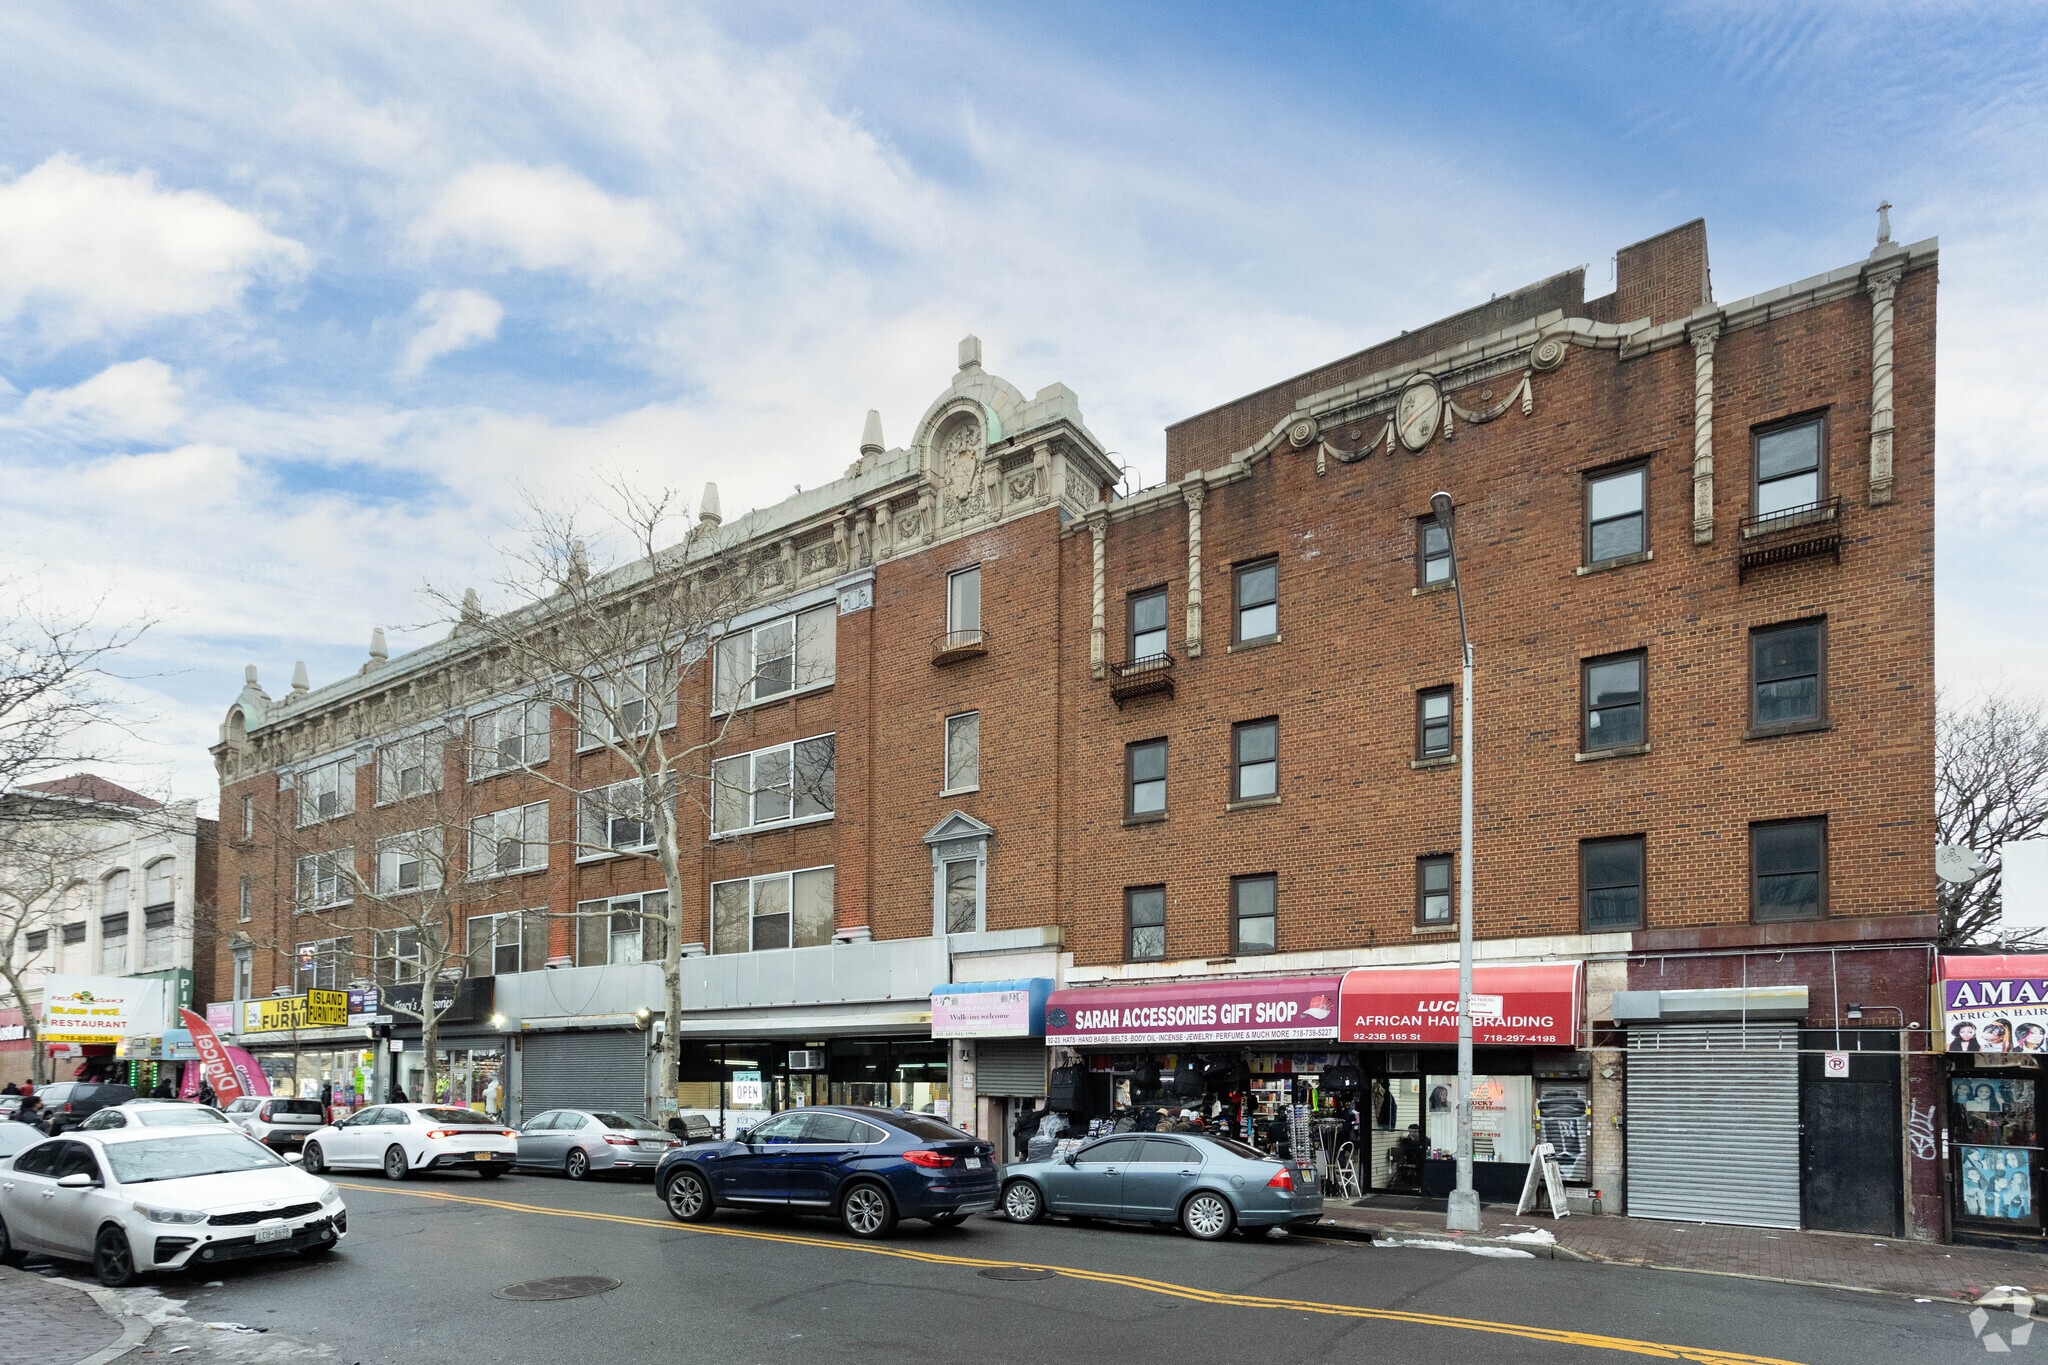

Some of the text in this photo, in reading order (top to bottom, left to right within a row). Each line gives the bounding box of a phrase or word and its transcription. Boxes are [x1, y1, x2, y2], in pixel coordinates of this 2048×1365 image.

[313, 992, 342, 1005] ISLAND
[277, 1000, 307, 1012] ISLA
[1418, 1000, 1460, 1012] LUC
[310, 1005, 346, 1022] FURNITURE
[1075, 1001, 1298, 1030] SARAH ACCESSORIES GIFT SHOP
[1951, 1008, 2048, 1020] AFRICAN HAIR
[50, 1019, 127, 1028] RESTAURANT
[262, 1012, 306, 1029] FURNI
[1355, 1016, 1422, 1026] AFRICAN
[1473, 1016, 1554, 1027] BRAIDING
[1271, 1030, 1290, 1038] MORE
[1293, 1029, 1332, 1037] 718-739-5227
[1484, 1034, 1556, 1042] 718-297-4198
[737, 1086, 758, 1099] OPEN
